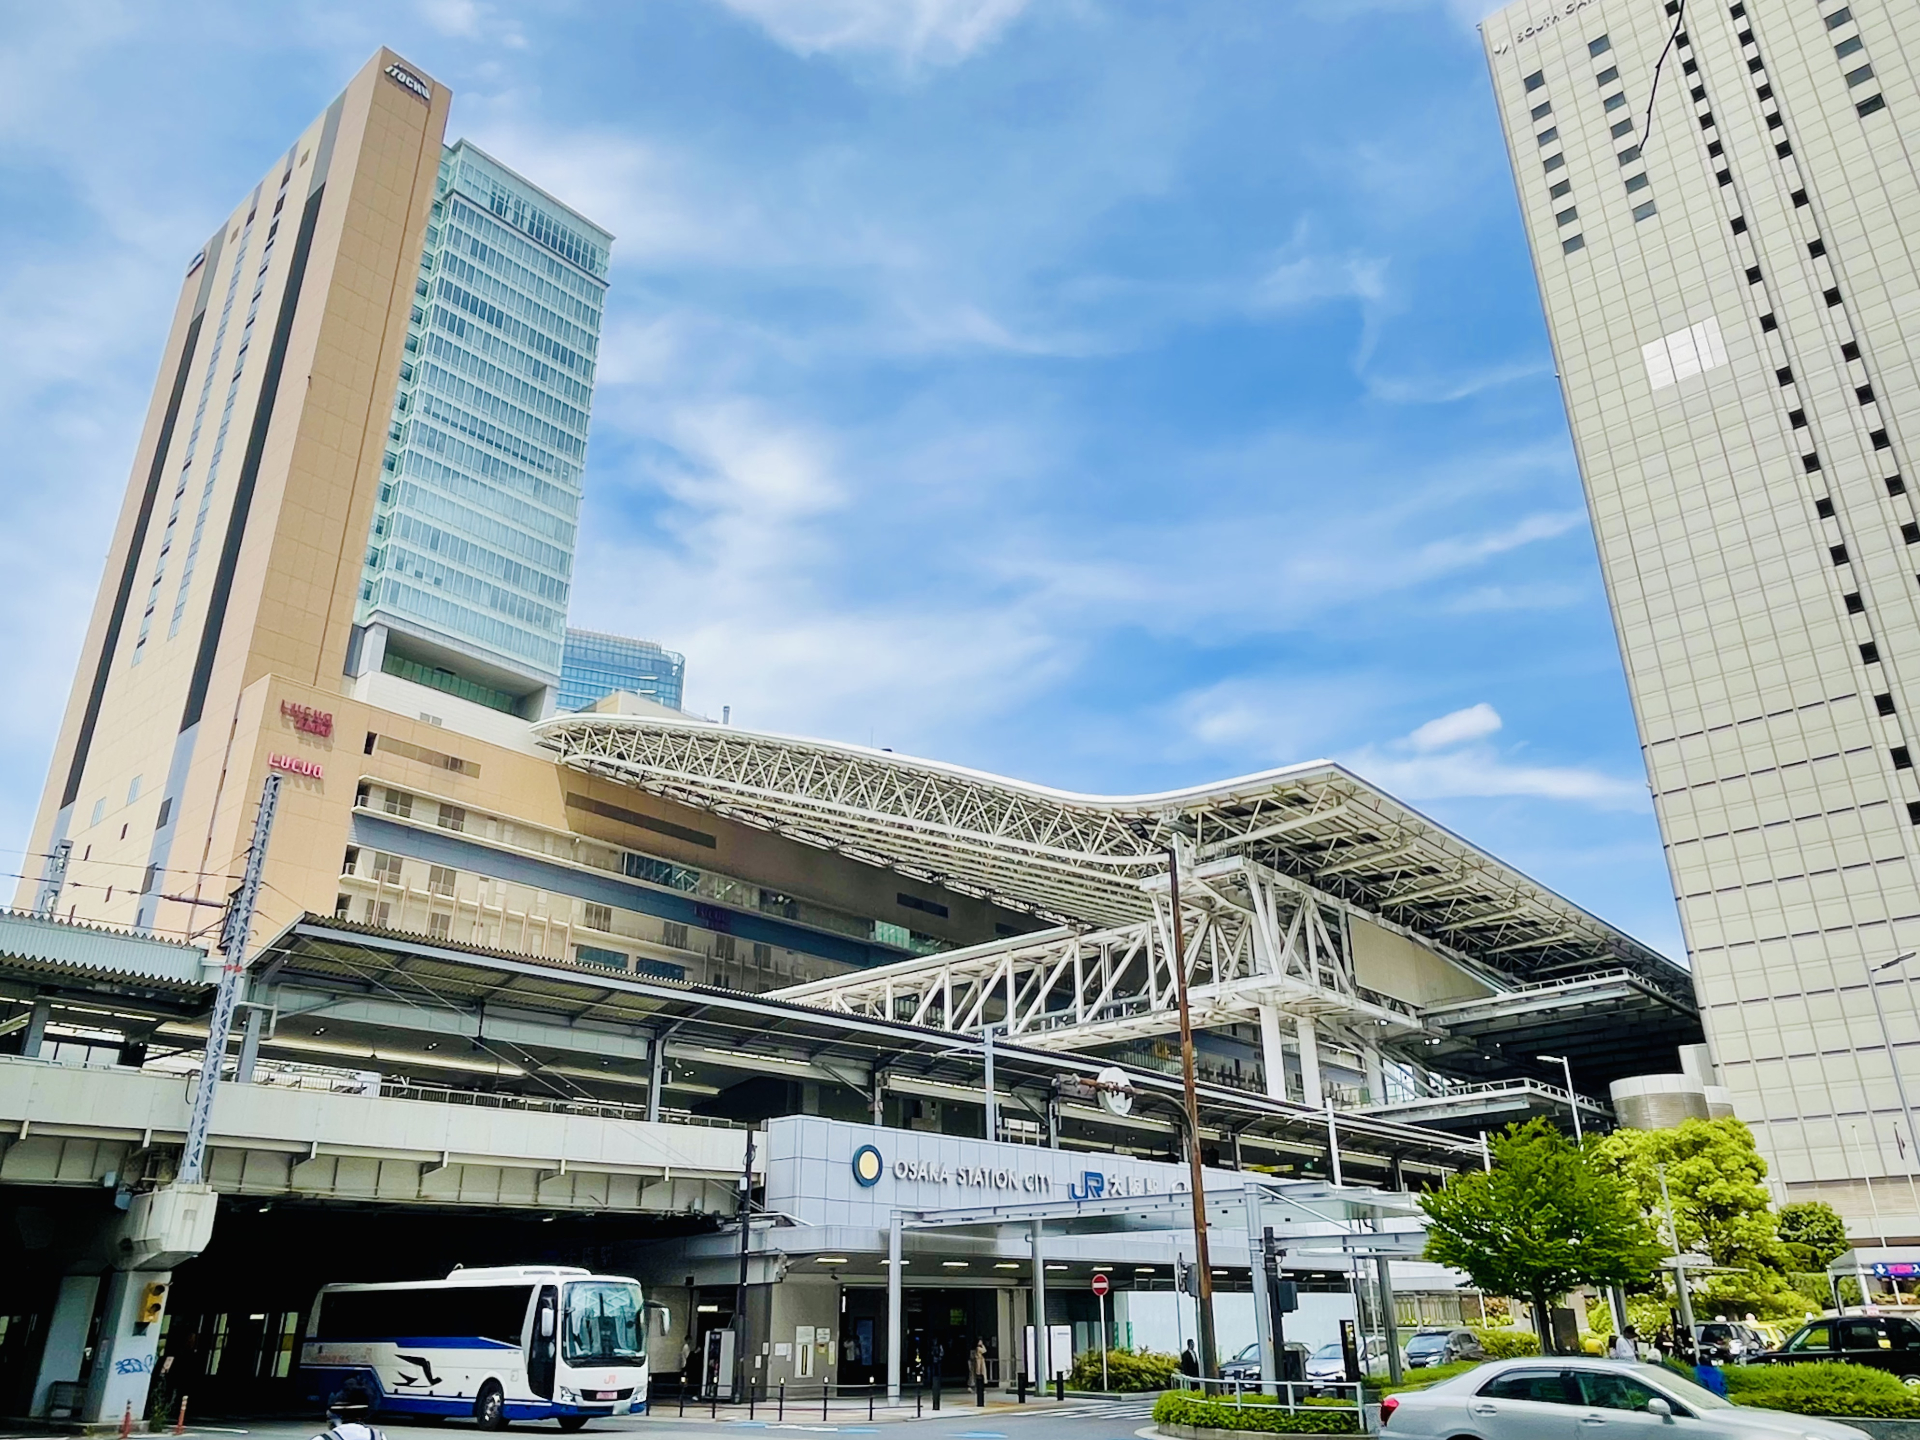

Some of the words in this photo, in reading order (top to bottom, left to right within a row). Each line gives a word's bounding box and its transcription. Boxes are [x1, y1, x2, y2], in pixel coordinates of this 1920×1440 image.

[384, 65, 431, 100] ITOCHU
[268, 752, 324, 778] LUCUA
[893, 1159, 950, 1184] OSAKA
[956, 1165, 1018, 1191] STATION
[1023, 1172, 1052, 1194] CITY
[1067, 1171, 1104, 1200] JR
